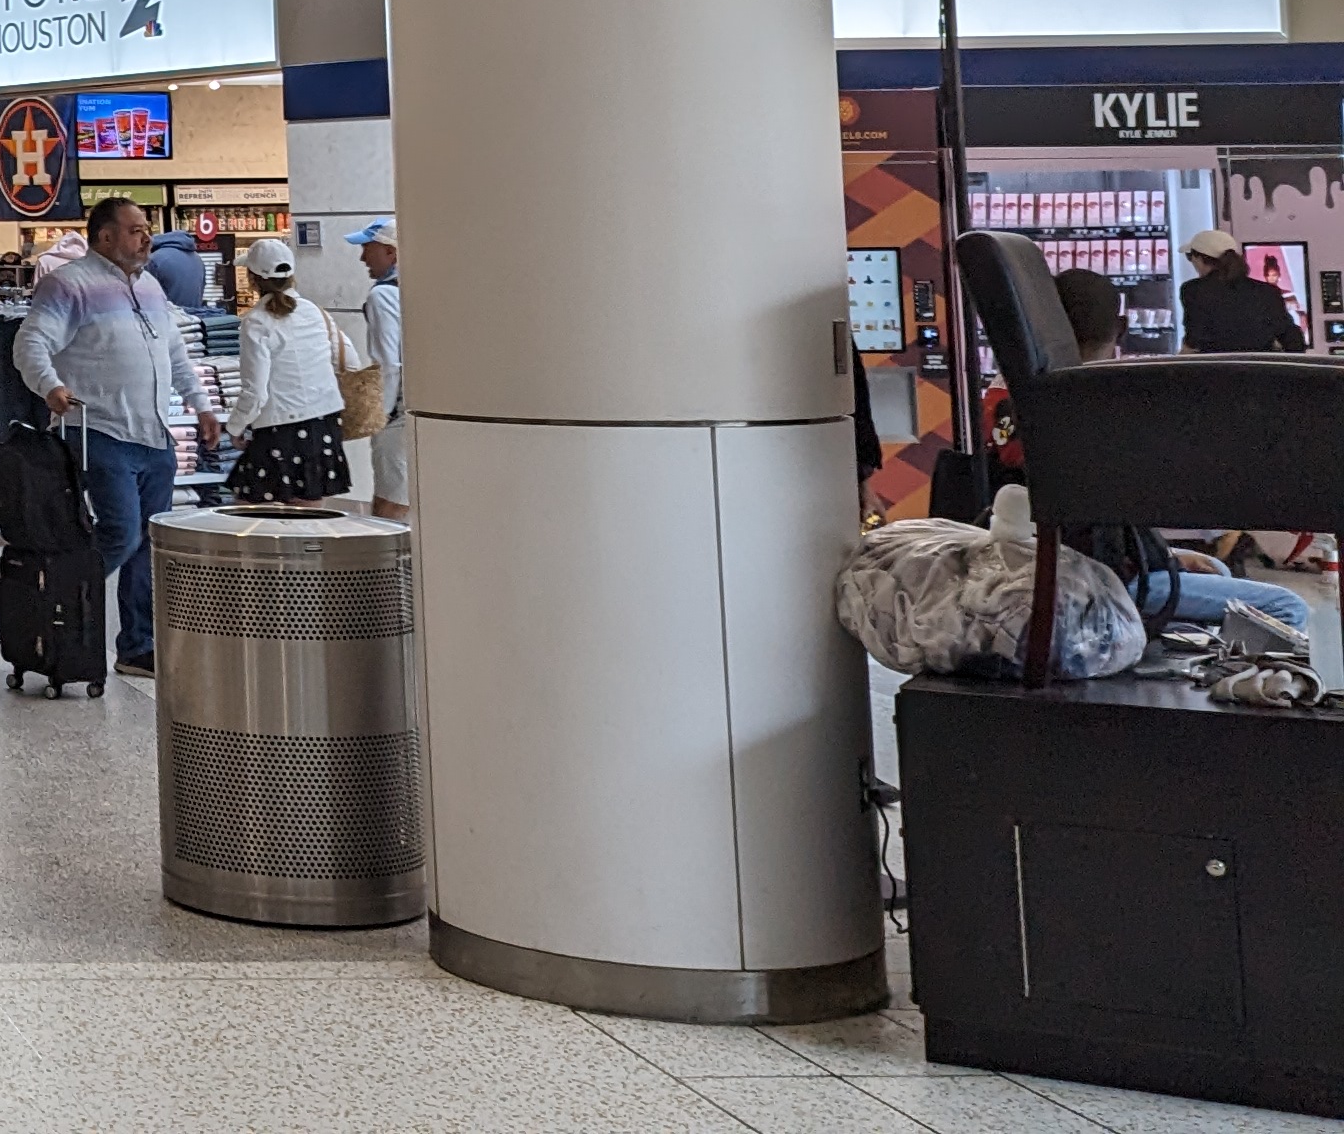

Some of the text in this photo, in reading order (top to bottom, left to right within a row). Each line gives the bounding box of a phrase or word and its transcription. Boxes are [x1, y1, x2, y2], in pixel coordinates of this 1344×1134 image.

[1093, 92, 1200, 128] KYLIE
[1118, 129, 1178, 139] KYLIE JENNER
